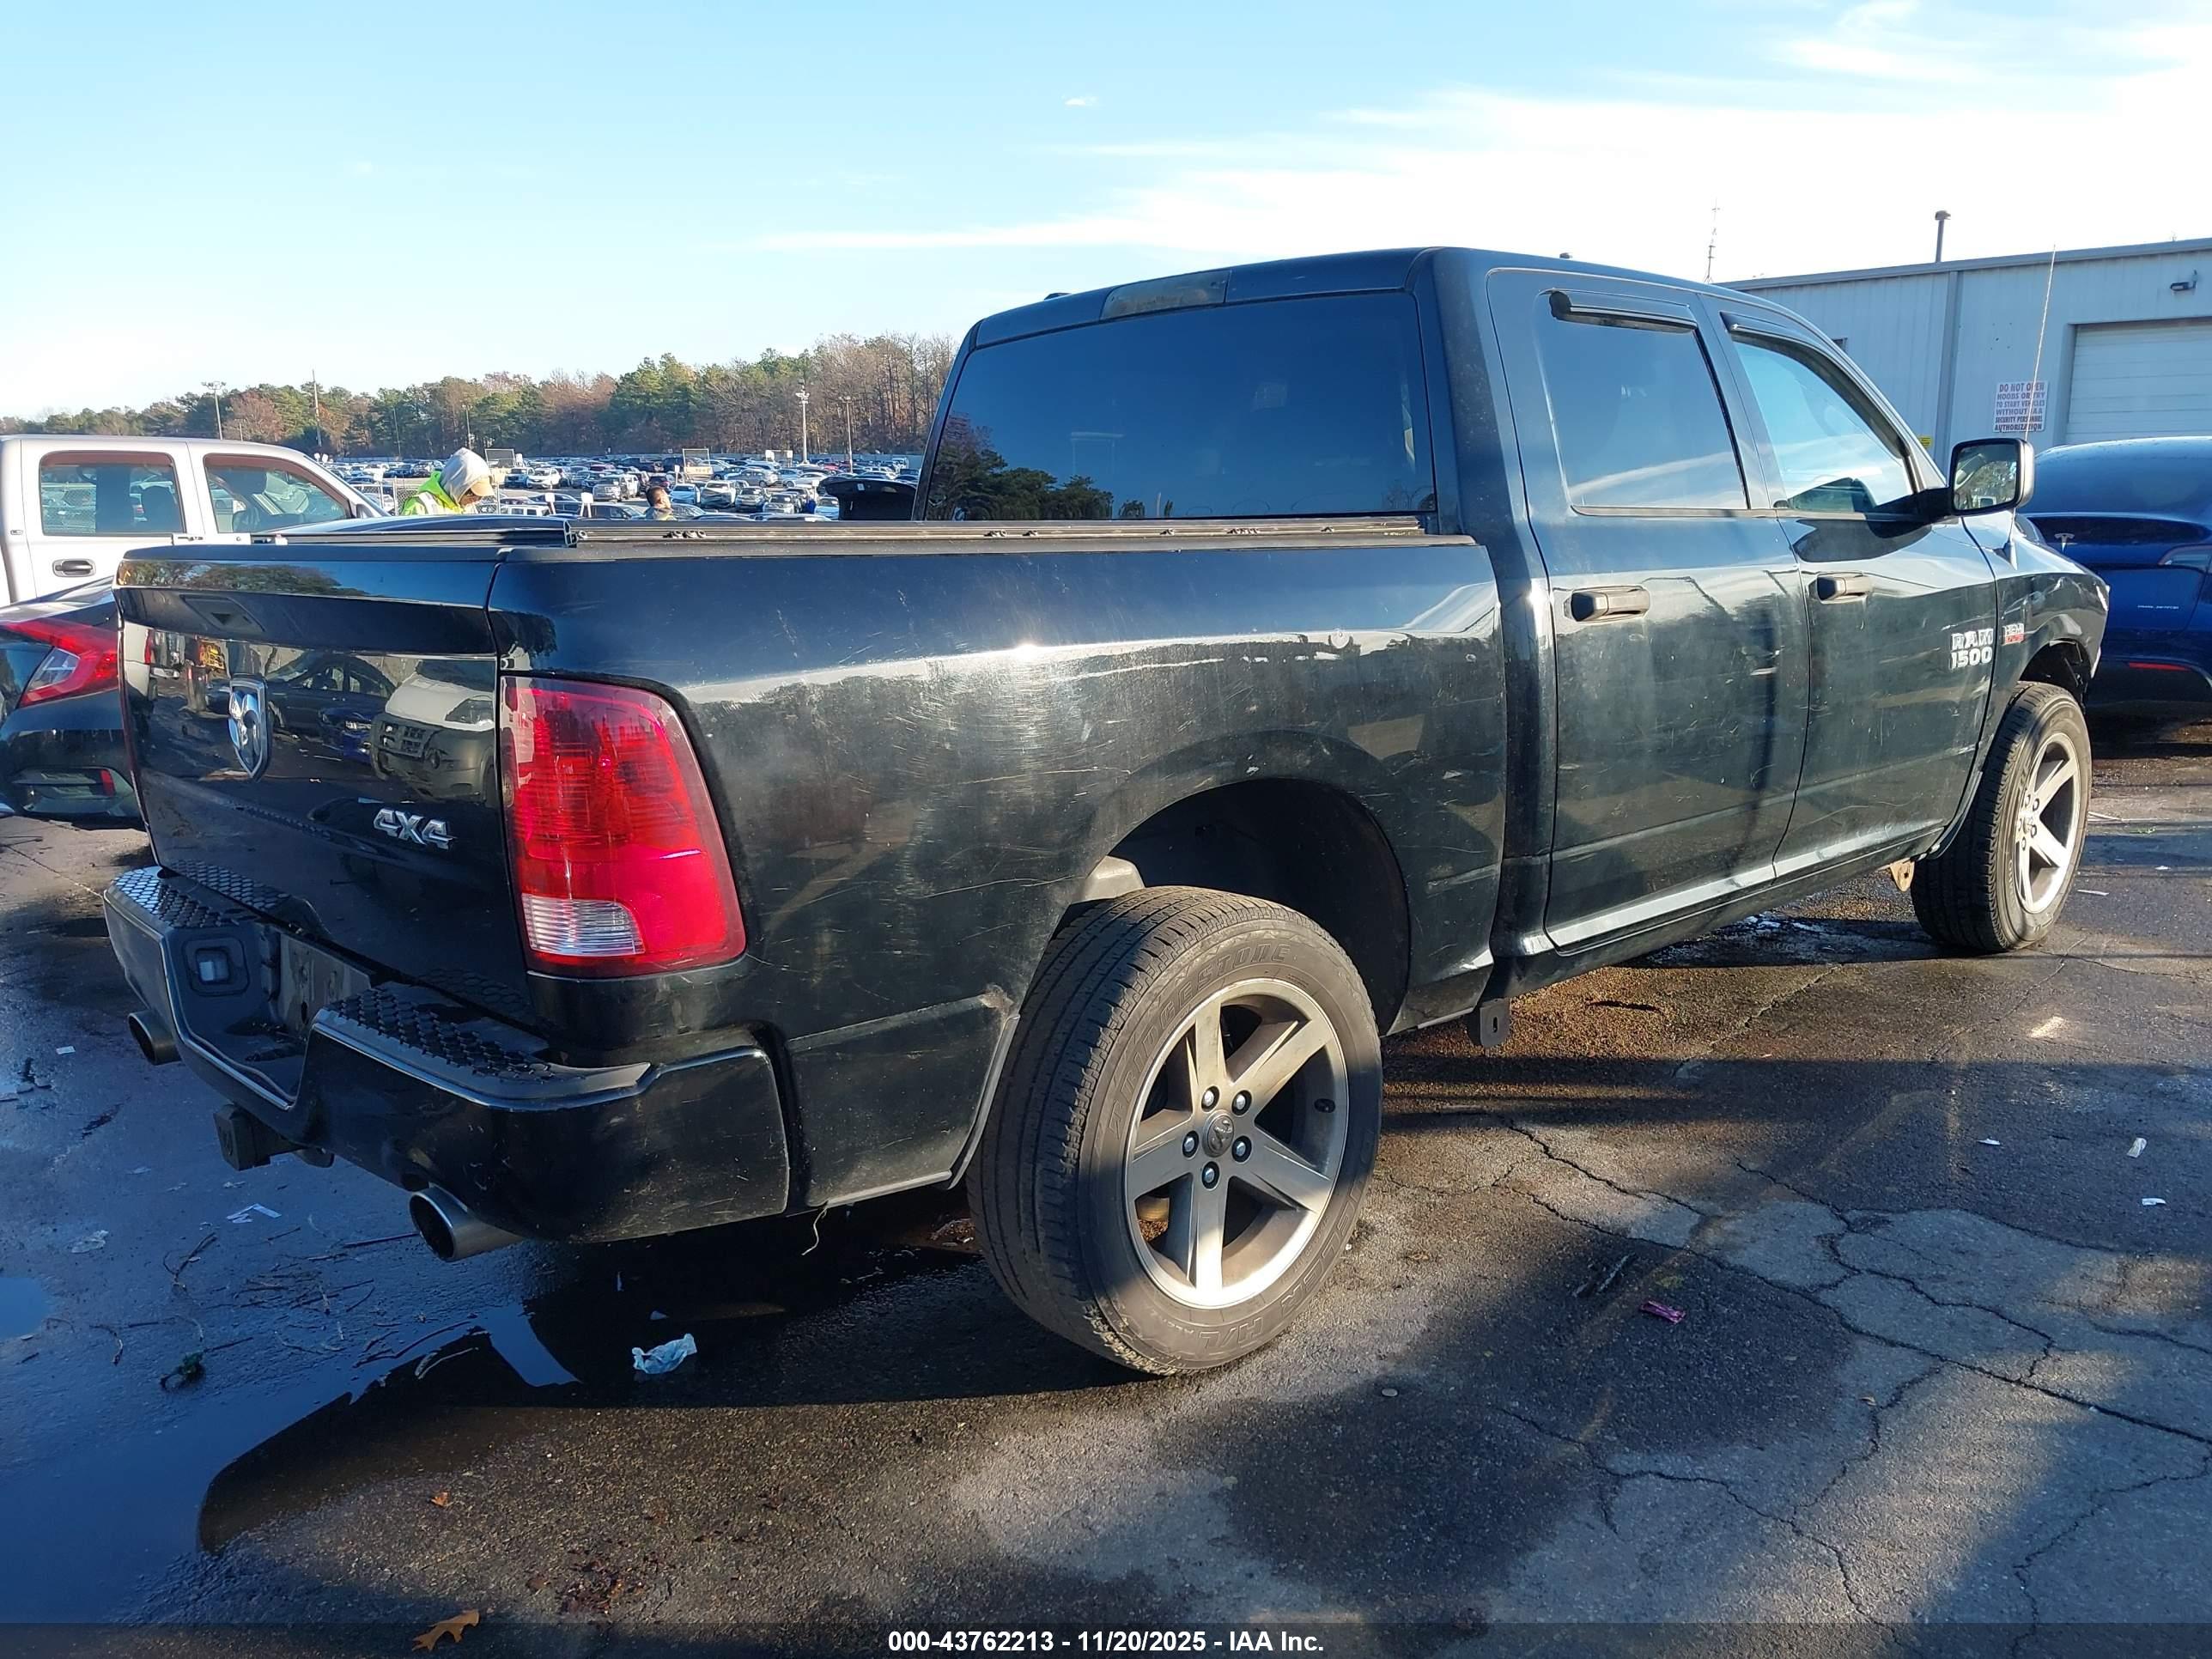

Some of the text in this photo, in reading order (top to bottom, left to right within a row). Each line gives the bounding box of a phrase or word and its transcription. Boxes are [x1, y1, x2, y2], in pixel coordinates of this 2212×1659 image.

[1999, 383, 2009, 393] DO
[2010, 382, 2025, 392] NOT
[1996, 392, 2020, 401] HOODS
[2021, 392, 2031, 400] OR
[1995, 416, 2016, 424] SECURITY
[1951, 629, 1993, 652] RAM
[1950, 647, 1993, 670] 1500
[1108, 943, 1292, 1140] BRIDGESTONE
